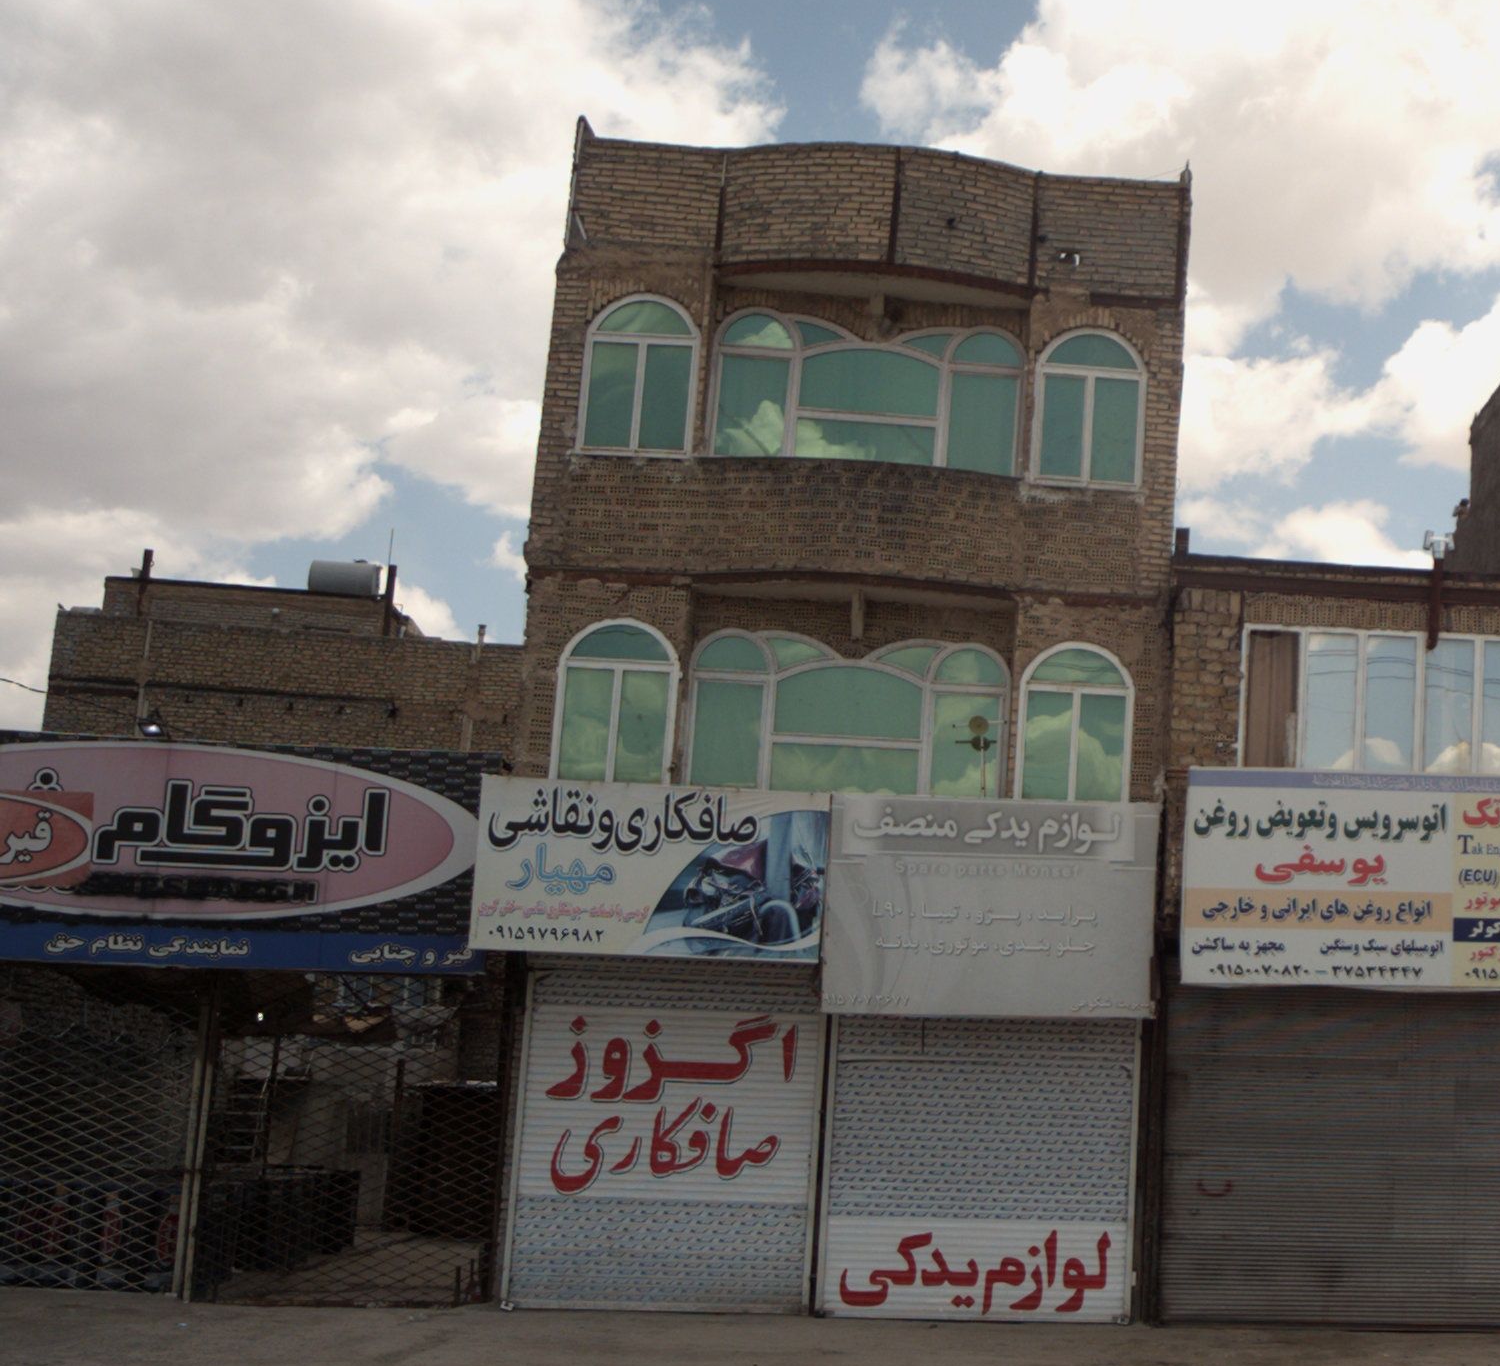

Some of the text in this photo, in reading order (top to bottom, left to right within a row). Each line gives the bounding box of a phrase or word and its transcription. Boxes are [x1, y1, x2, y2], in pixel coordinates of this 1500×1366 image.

[91, 779, 390, 872] ایزوگام
[853, 805, 1121, 854] لوازم یدکی منصف
[1193, 798, 1249, 837] روغن
[1254, 843, 1389, 885] یوسفی
[1457, 834, 1483, 856] Tak
[506, 842, 617, 895] مهیار
[895, 860, 949, 876] Spare
[1320, 898, 1350, 921] های
[1352, 899, 1391, 922] روغن
[148, 935, 251, 960] نمایندگی
[545, 1014, 799, 1103] اگزوز
[549, 1095, 781, 1196] صافکاری
[838, 1228, 1112, 1316] لوازم یدکی
